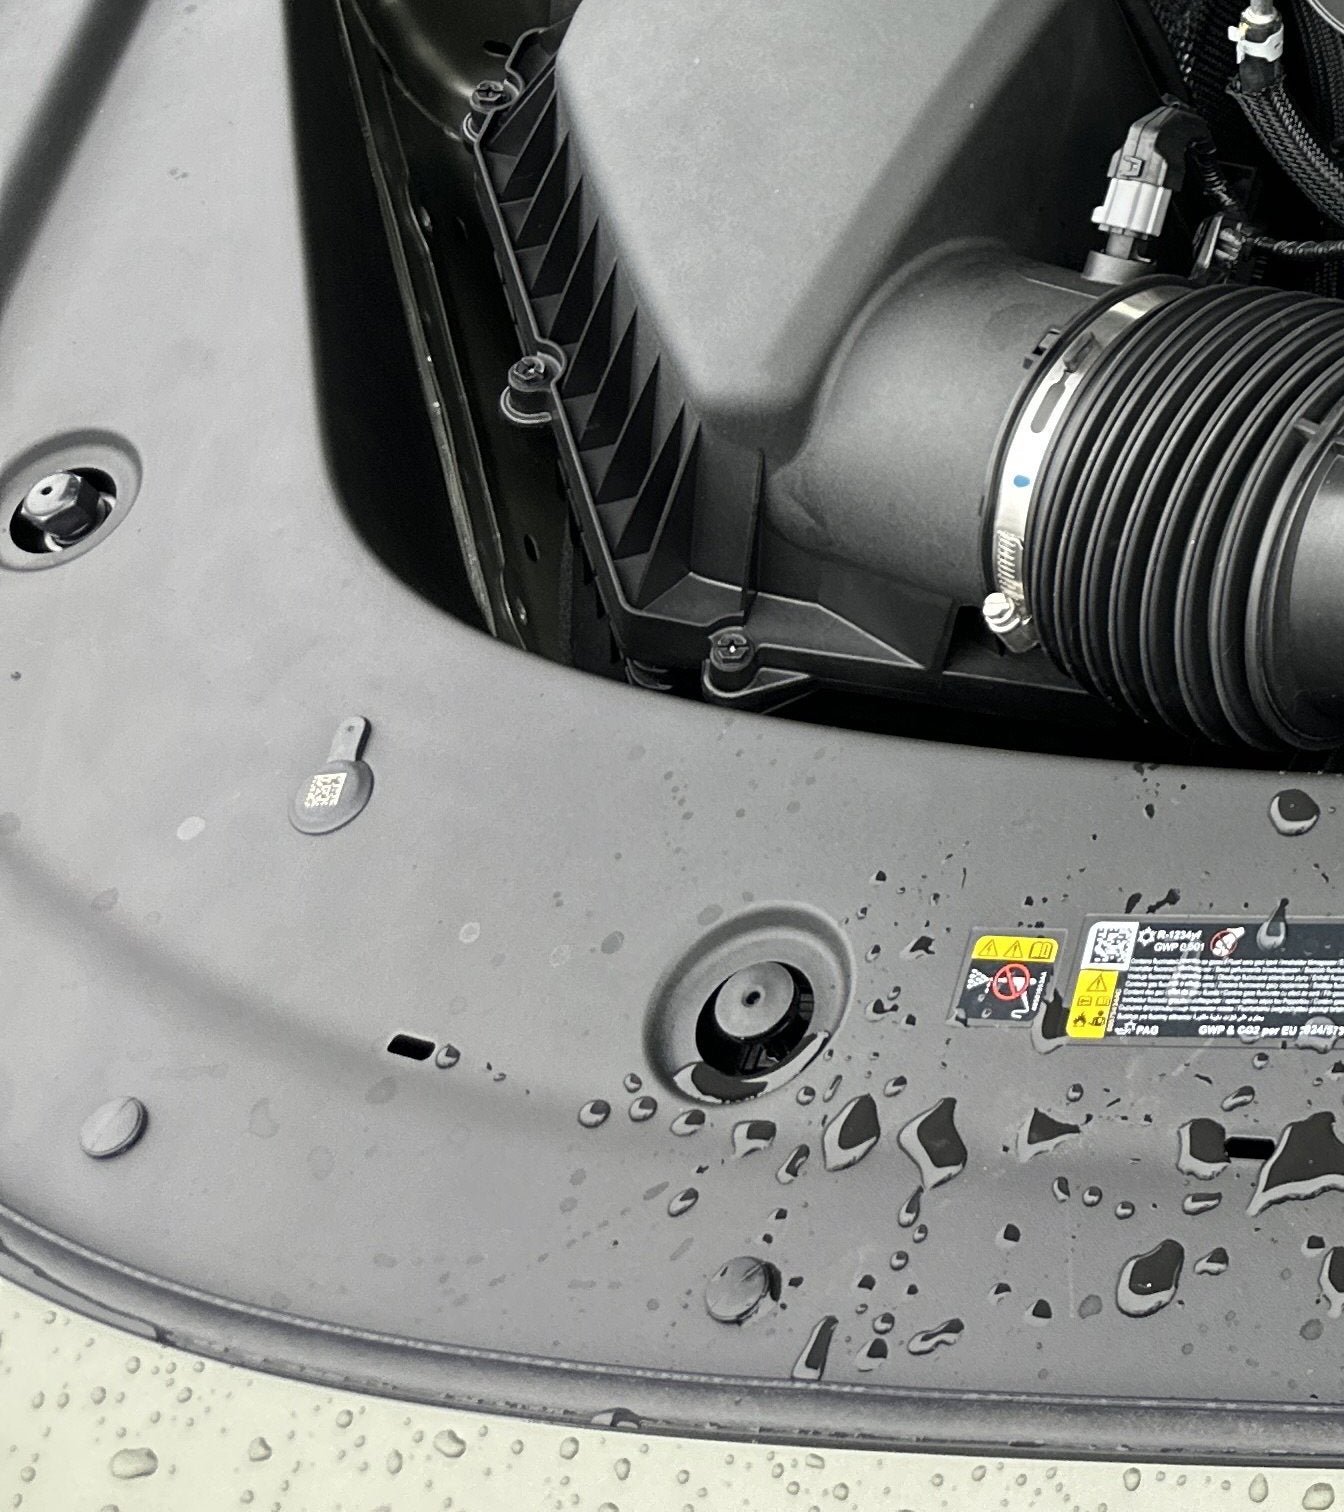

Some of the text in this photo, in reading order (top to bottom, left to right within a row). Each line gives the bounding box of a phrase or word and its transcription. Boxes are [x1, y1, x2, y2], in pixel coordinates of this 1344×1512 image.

[1153, 942, 1179, 952] GWP
[1198, 1025, 1225, 1036] GWP
[1281, 1025, 1298, 1036] EU
